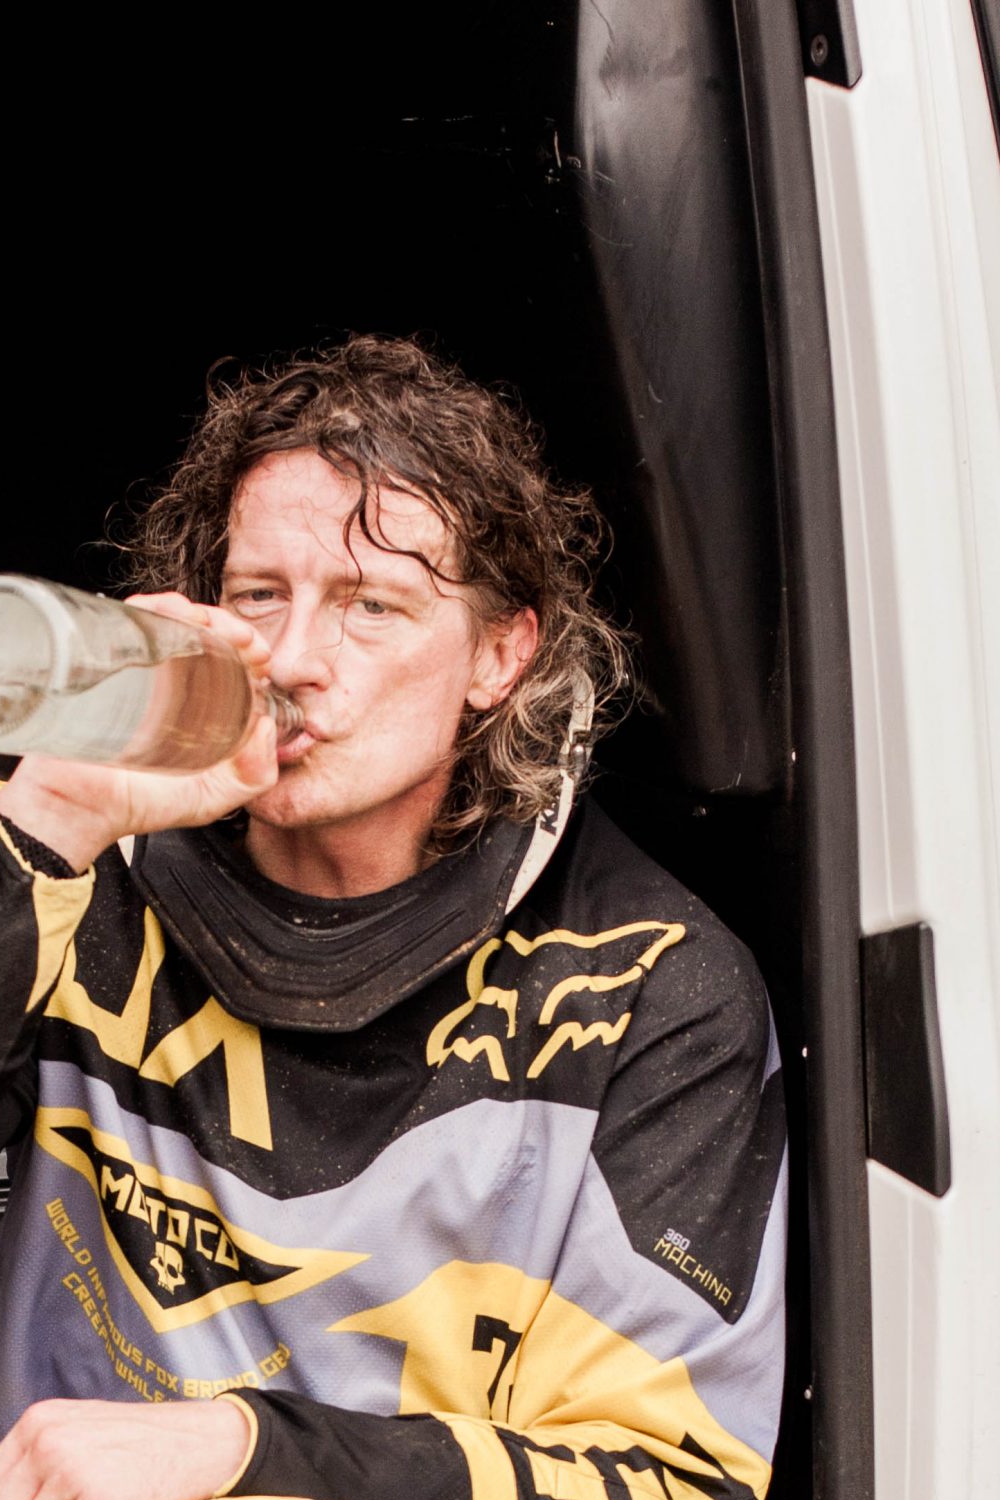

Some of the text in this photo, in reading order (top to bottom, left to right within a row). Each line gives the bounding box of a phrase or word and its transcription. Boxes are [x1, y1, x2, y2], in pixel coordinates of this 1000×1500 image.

[653, 1238, 733, 1306] MACHINA
[663, 1228, 691, 1251] 360
[46, 1198, 92, 1265] WORLD
[144, 1358, 178, 1393] FOX
